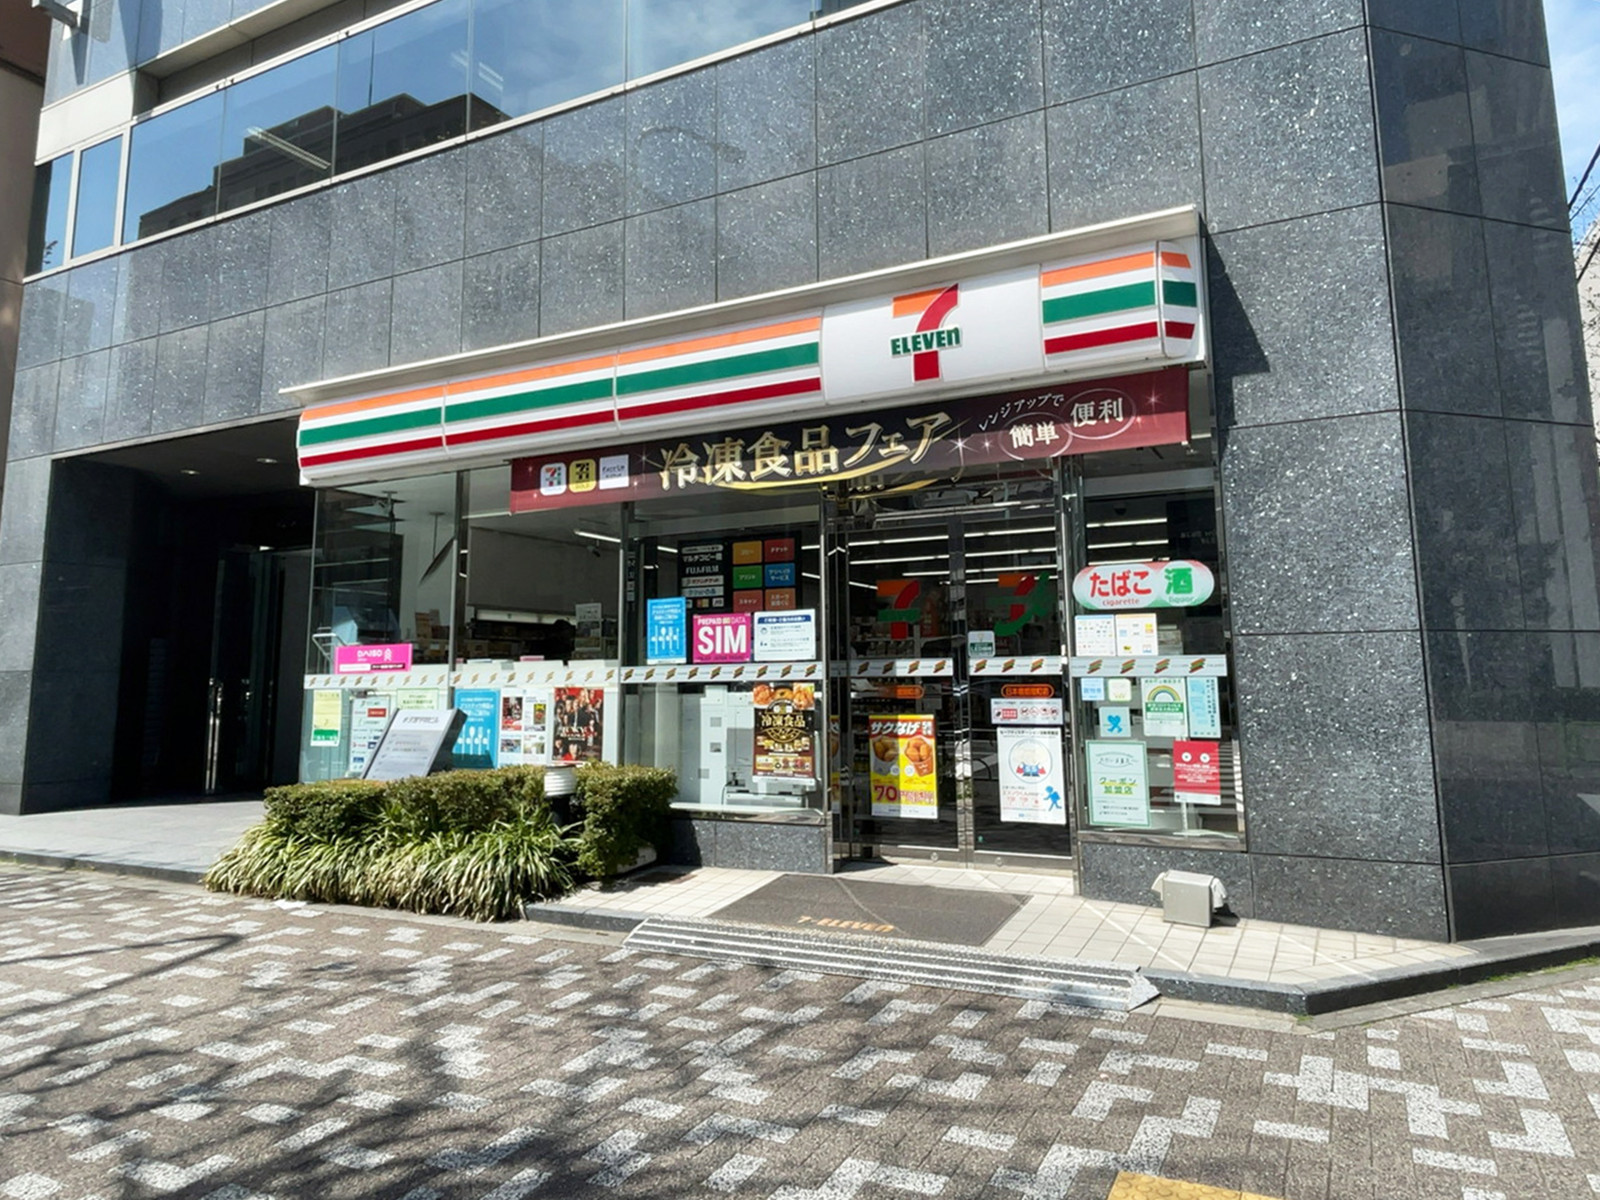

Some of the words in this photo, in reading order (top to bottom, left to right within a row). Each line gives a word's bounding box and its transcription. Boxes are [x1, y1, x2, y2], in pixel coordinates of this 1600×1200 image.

[978, 394, 1065, 431] レンジアップで
[1070, 397, 1124, 428] 便利
[1009, 421, 1059, 449] 簡単
[660, 411, 952, 491] 冷凍食品フェア
[1089, 570, 1152, 597] たばこ
[1164, 567, 1193, 594] 酒
[1102, 598, 1140, 606] cigarette
[357, 649, 383, 658] DAISO
[697, 624, 747, 655] SIM
[761, 714, 806, 728] 冷凍食品
[874, 784, 898, 802] 70
[1099, 777, 1136, 786] クーポン
